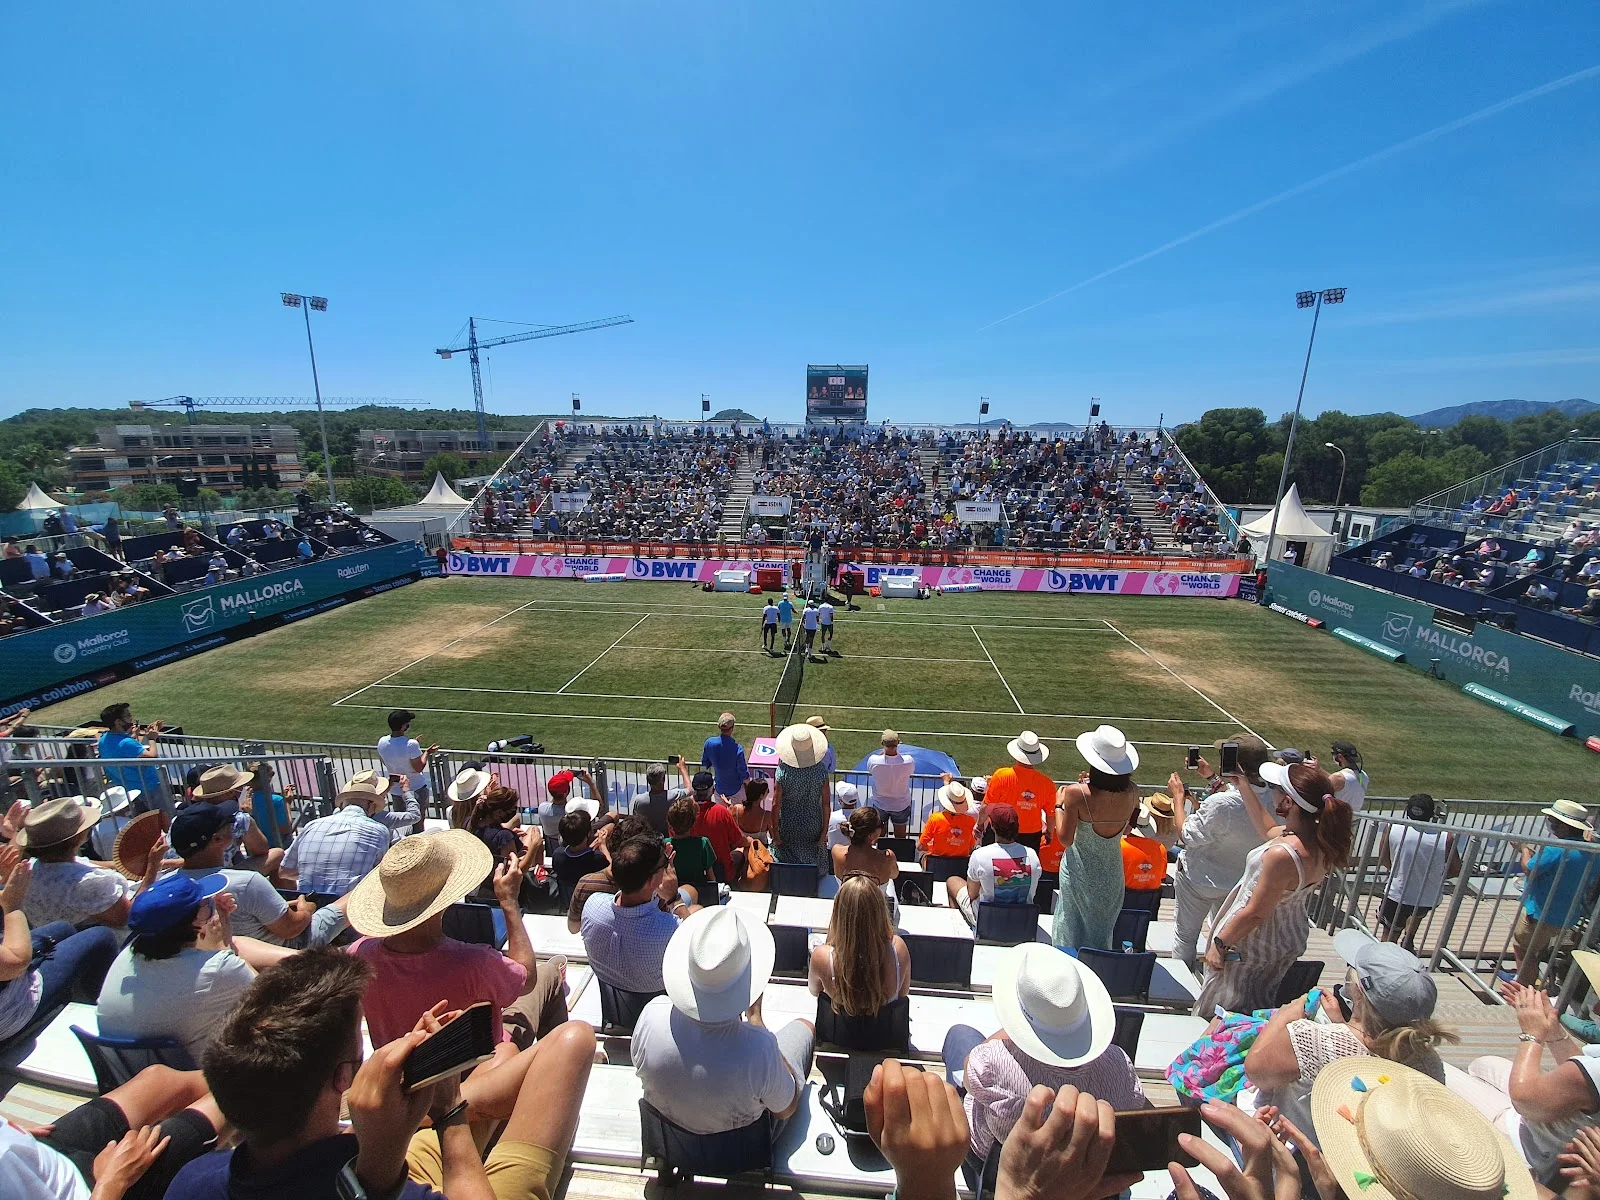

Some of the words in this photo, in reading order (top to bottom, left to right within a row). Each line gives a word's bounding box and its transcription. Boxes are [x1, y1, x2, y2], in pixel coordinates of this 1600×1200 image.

[337, 562, 370, 579] Rakuten
[467, 556, 510, 573] BWT
[651, 562, 697, 578] BWT
[973, 569, 1011, 577] CHANGE
[1069, 573, 1118, 590] BWT
[219, 578, 304, 612] MALLORCA
[223, 590, 306, 618] CHAMPIONSHIPS
[1322, 594, 1355, 611] Mallorca
[1320, 603, 1341, 615] Country
[1340, 609, 1353, 619] Club
[77, 629, 129, 649] Mallorca
[80, 642, 113, 657] Country
[113, 638, 131, 648] Club
[1416, 625, 1510, 674] MALLORCA
[1414, 640, 1509, 682] CHAMPIONSHIPS
[1472, 687, 1508, 706] BancoMarch
[0, 696, 40, 718] omos
[1521, 708, 1564, 730] BancoMarch
